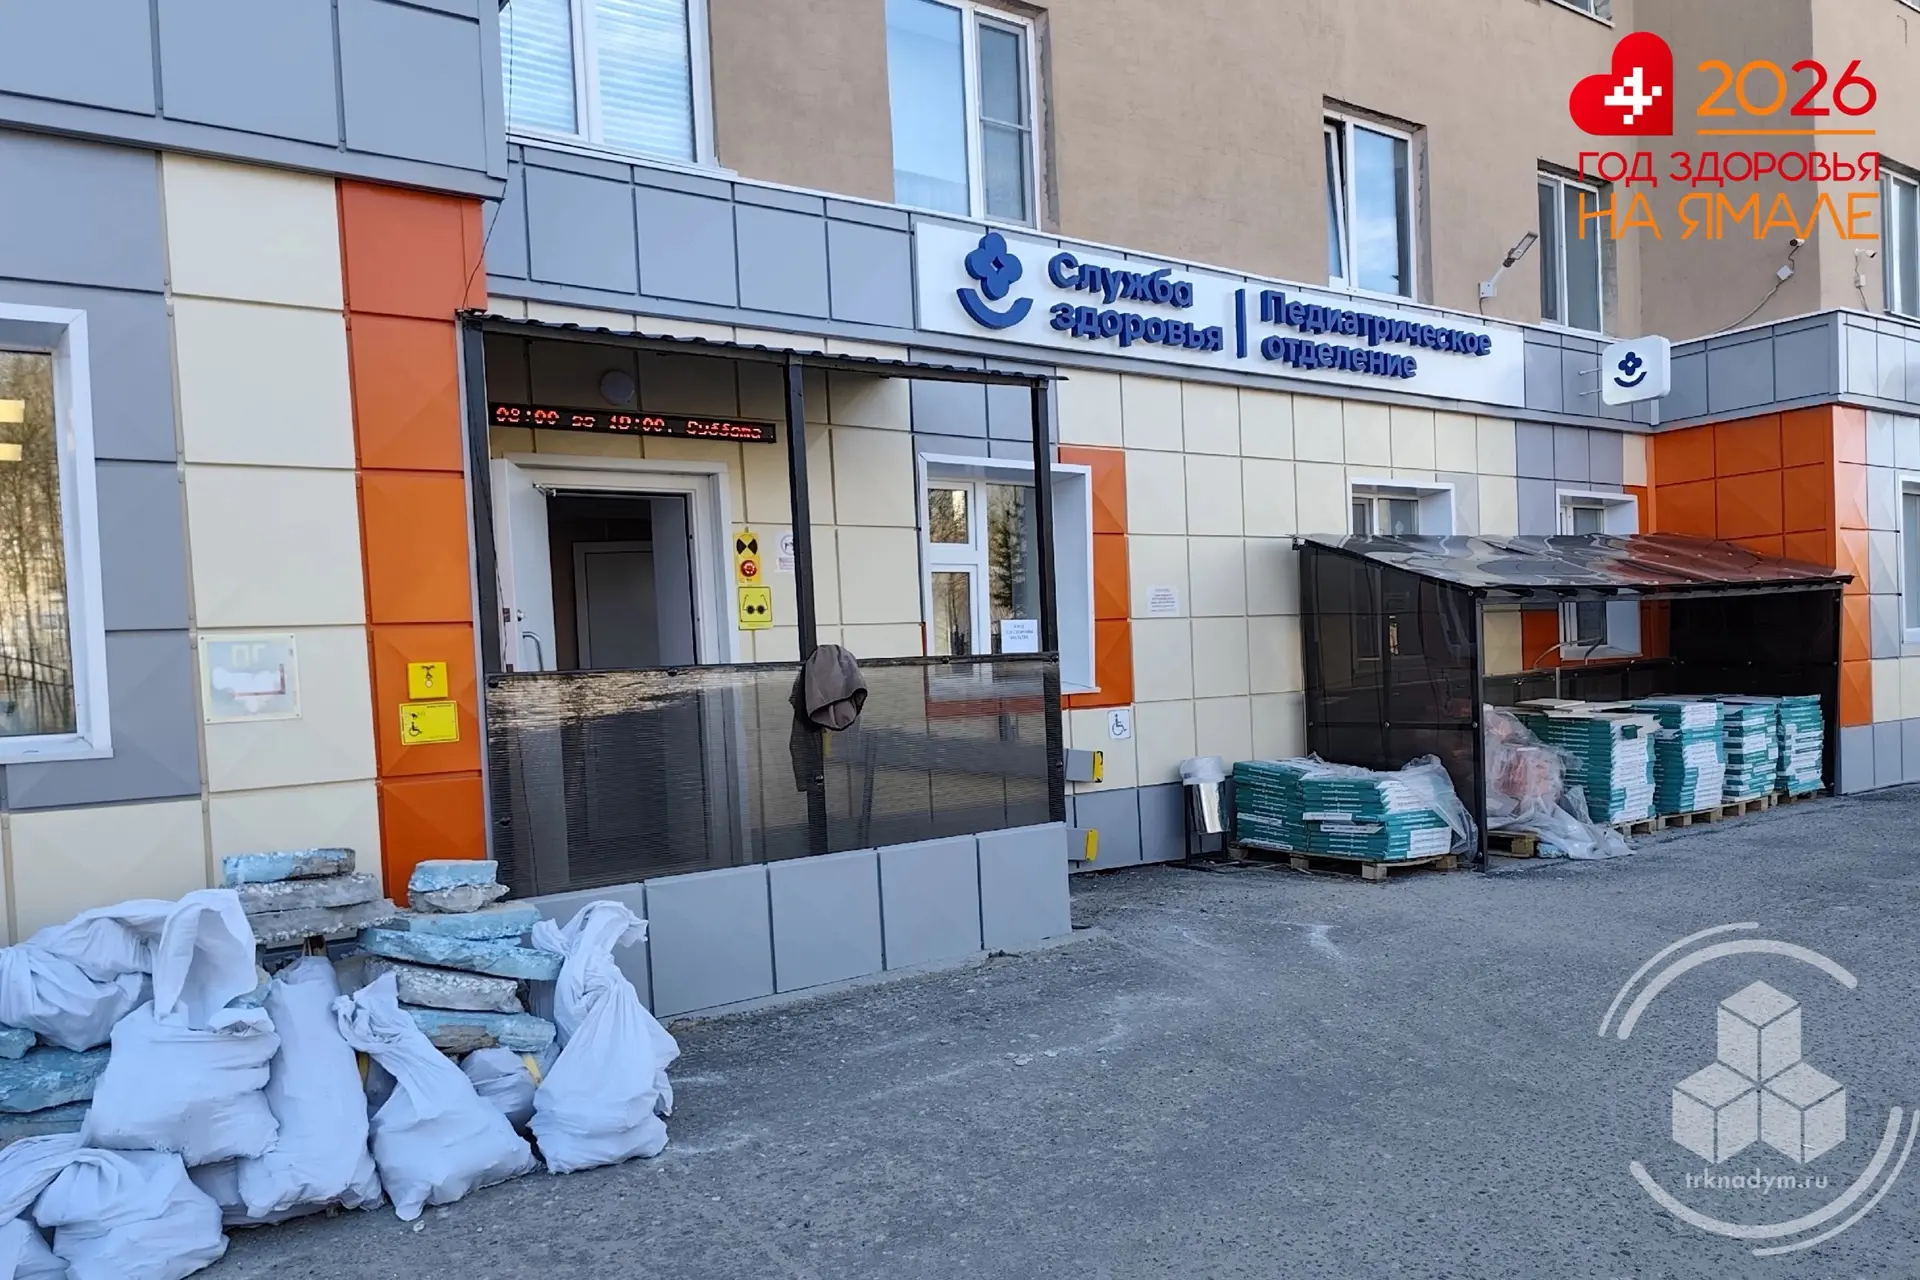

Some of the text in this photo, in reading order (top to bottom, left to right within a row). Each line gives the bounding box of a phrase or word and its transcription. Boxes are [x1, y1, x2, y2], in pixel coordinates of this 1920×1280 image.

[1048, 252, 1194, 309] Служба
[1049, 302, 1224, 351] здоровья
[1260, 289, 1491, 357] Педиатрическое
[1261, 334, 1418, 379] отделение
